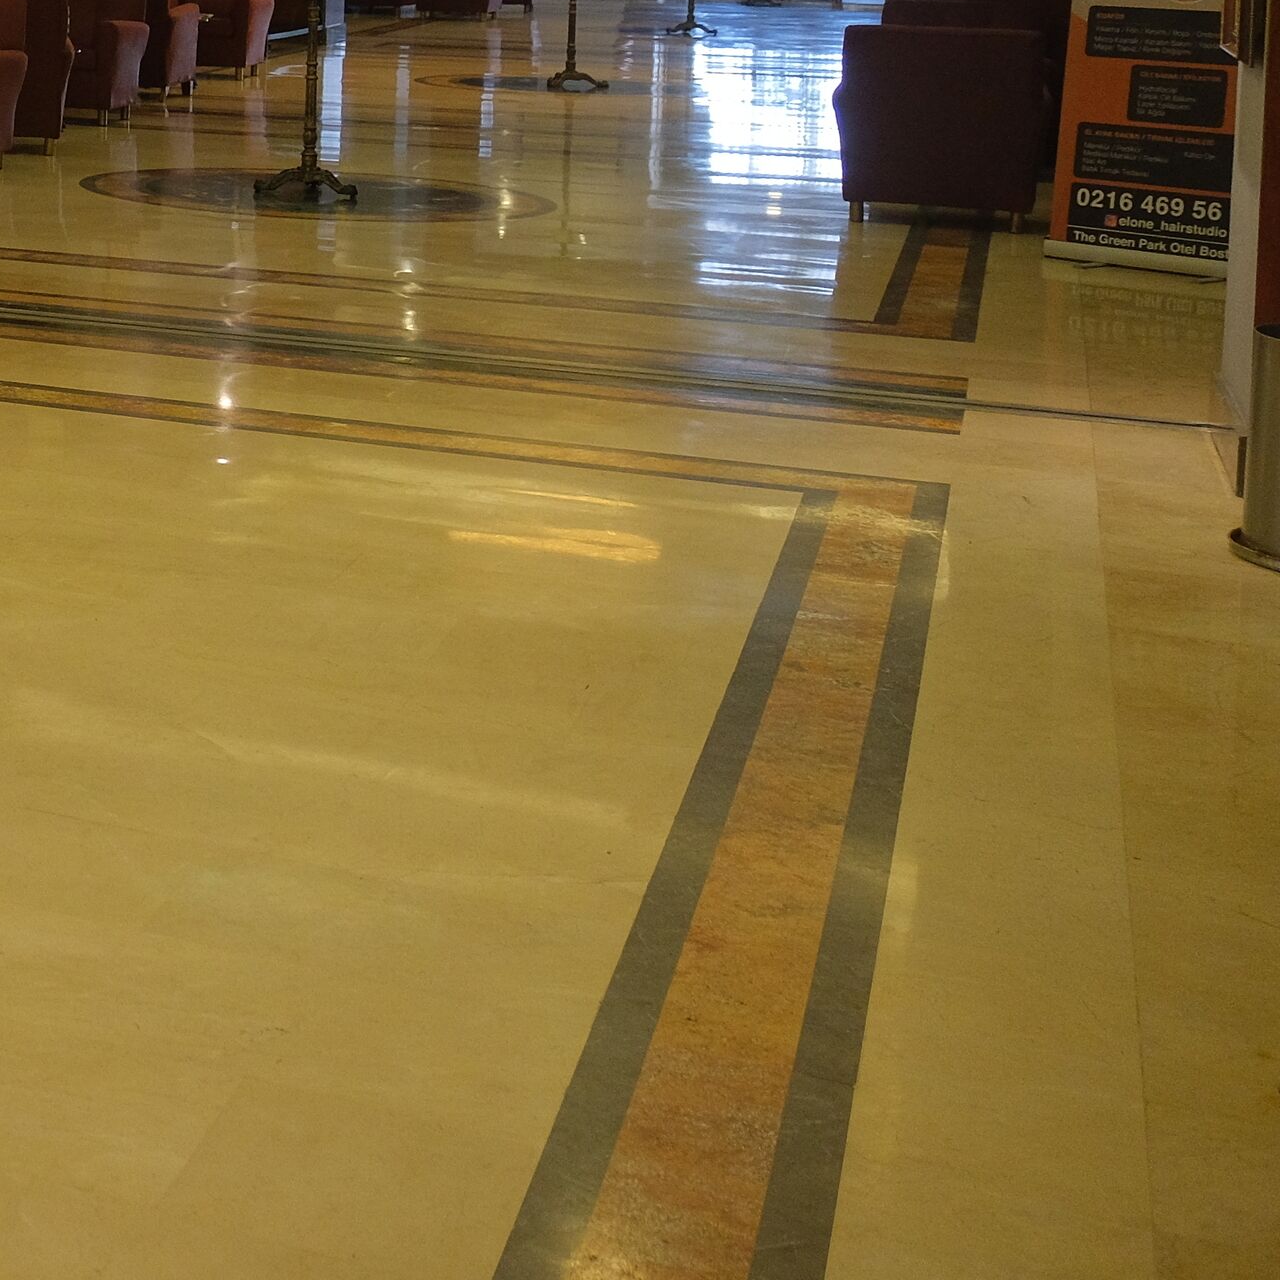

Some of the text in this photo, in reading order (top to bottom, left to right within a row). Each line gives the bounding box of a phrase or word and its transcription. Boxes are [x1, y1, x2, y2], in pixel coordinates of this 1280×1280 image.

[1076, 187, 1223, 222] 0216 469 56
[1073, 230, 1096, 243] The
[1098, 233, 1135, 249] Green
[1139, 238, 1167, 252] Park
[1170, 242, 1196, 255] Otel
